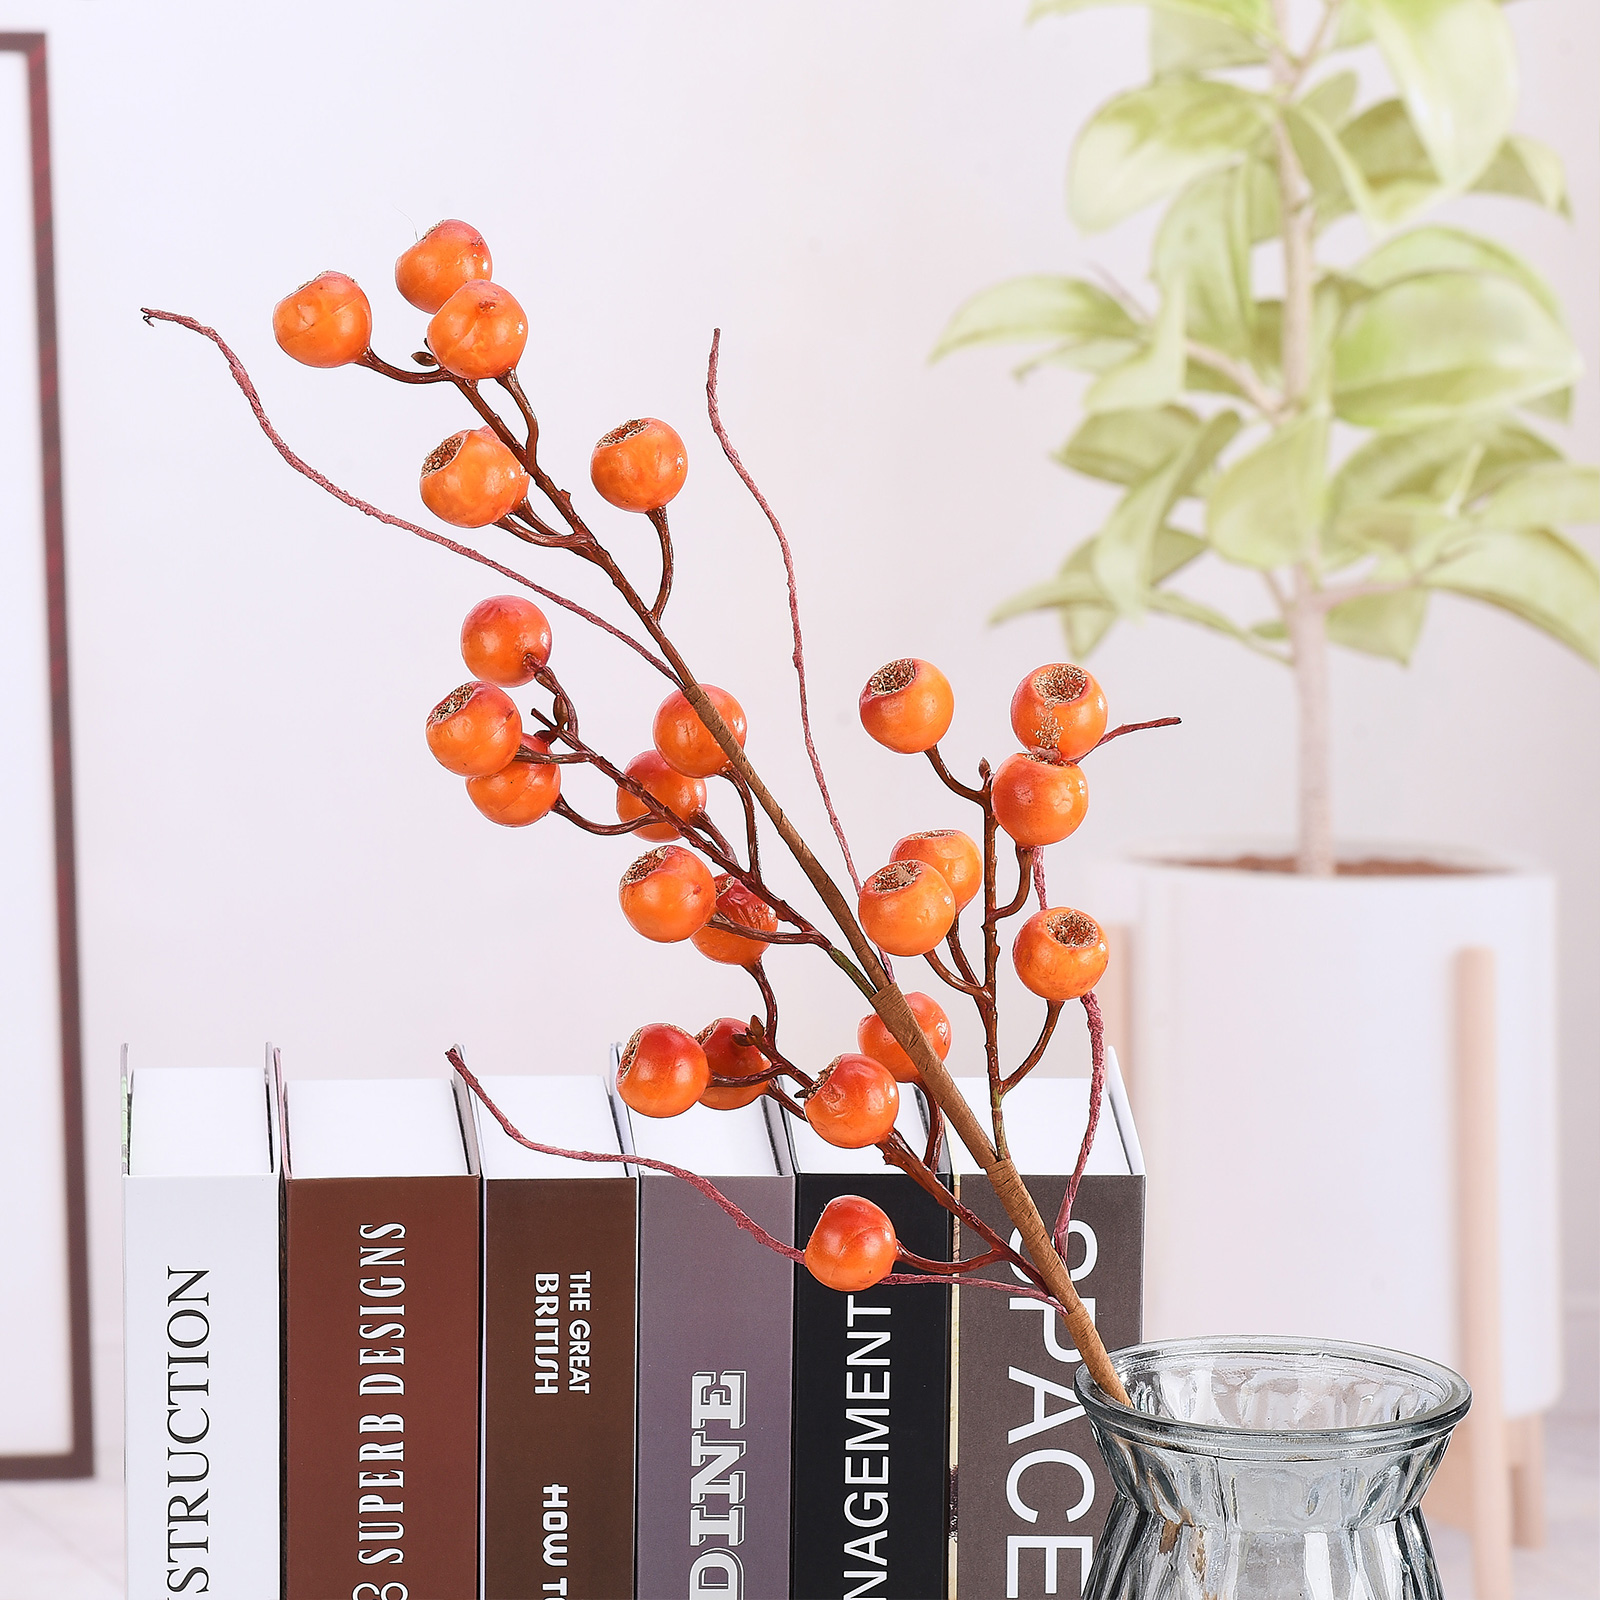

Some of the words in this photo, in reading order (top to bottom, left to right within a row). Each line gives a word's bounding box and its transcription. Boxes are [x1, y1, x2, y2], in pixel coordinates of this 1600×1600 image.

[358, 1222, 408, 1396] DESIGNS
[534, 1273, 560, 1394] BRITISH
[568, 1319, 591, 1394] GREAT
[569, 1270, 592, 1312] THE
[166, 1265, 210, 1600] STRUCTION
[689, 1370, 748, 1600] DINE
[843, 1294, 893, 1600] NAGEMENT
[1004, 1219, 1099, 1600] SPACE
[357, 1413, 406, 1565] SUPERB
[541, 1483, 569, 1567] HOW
[541, 1576, 569, 1600] T
